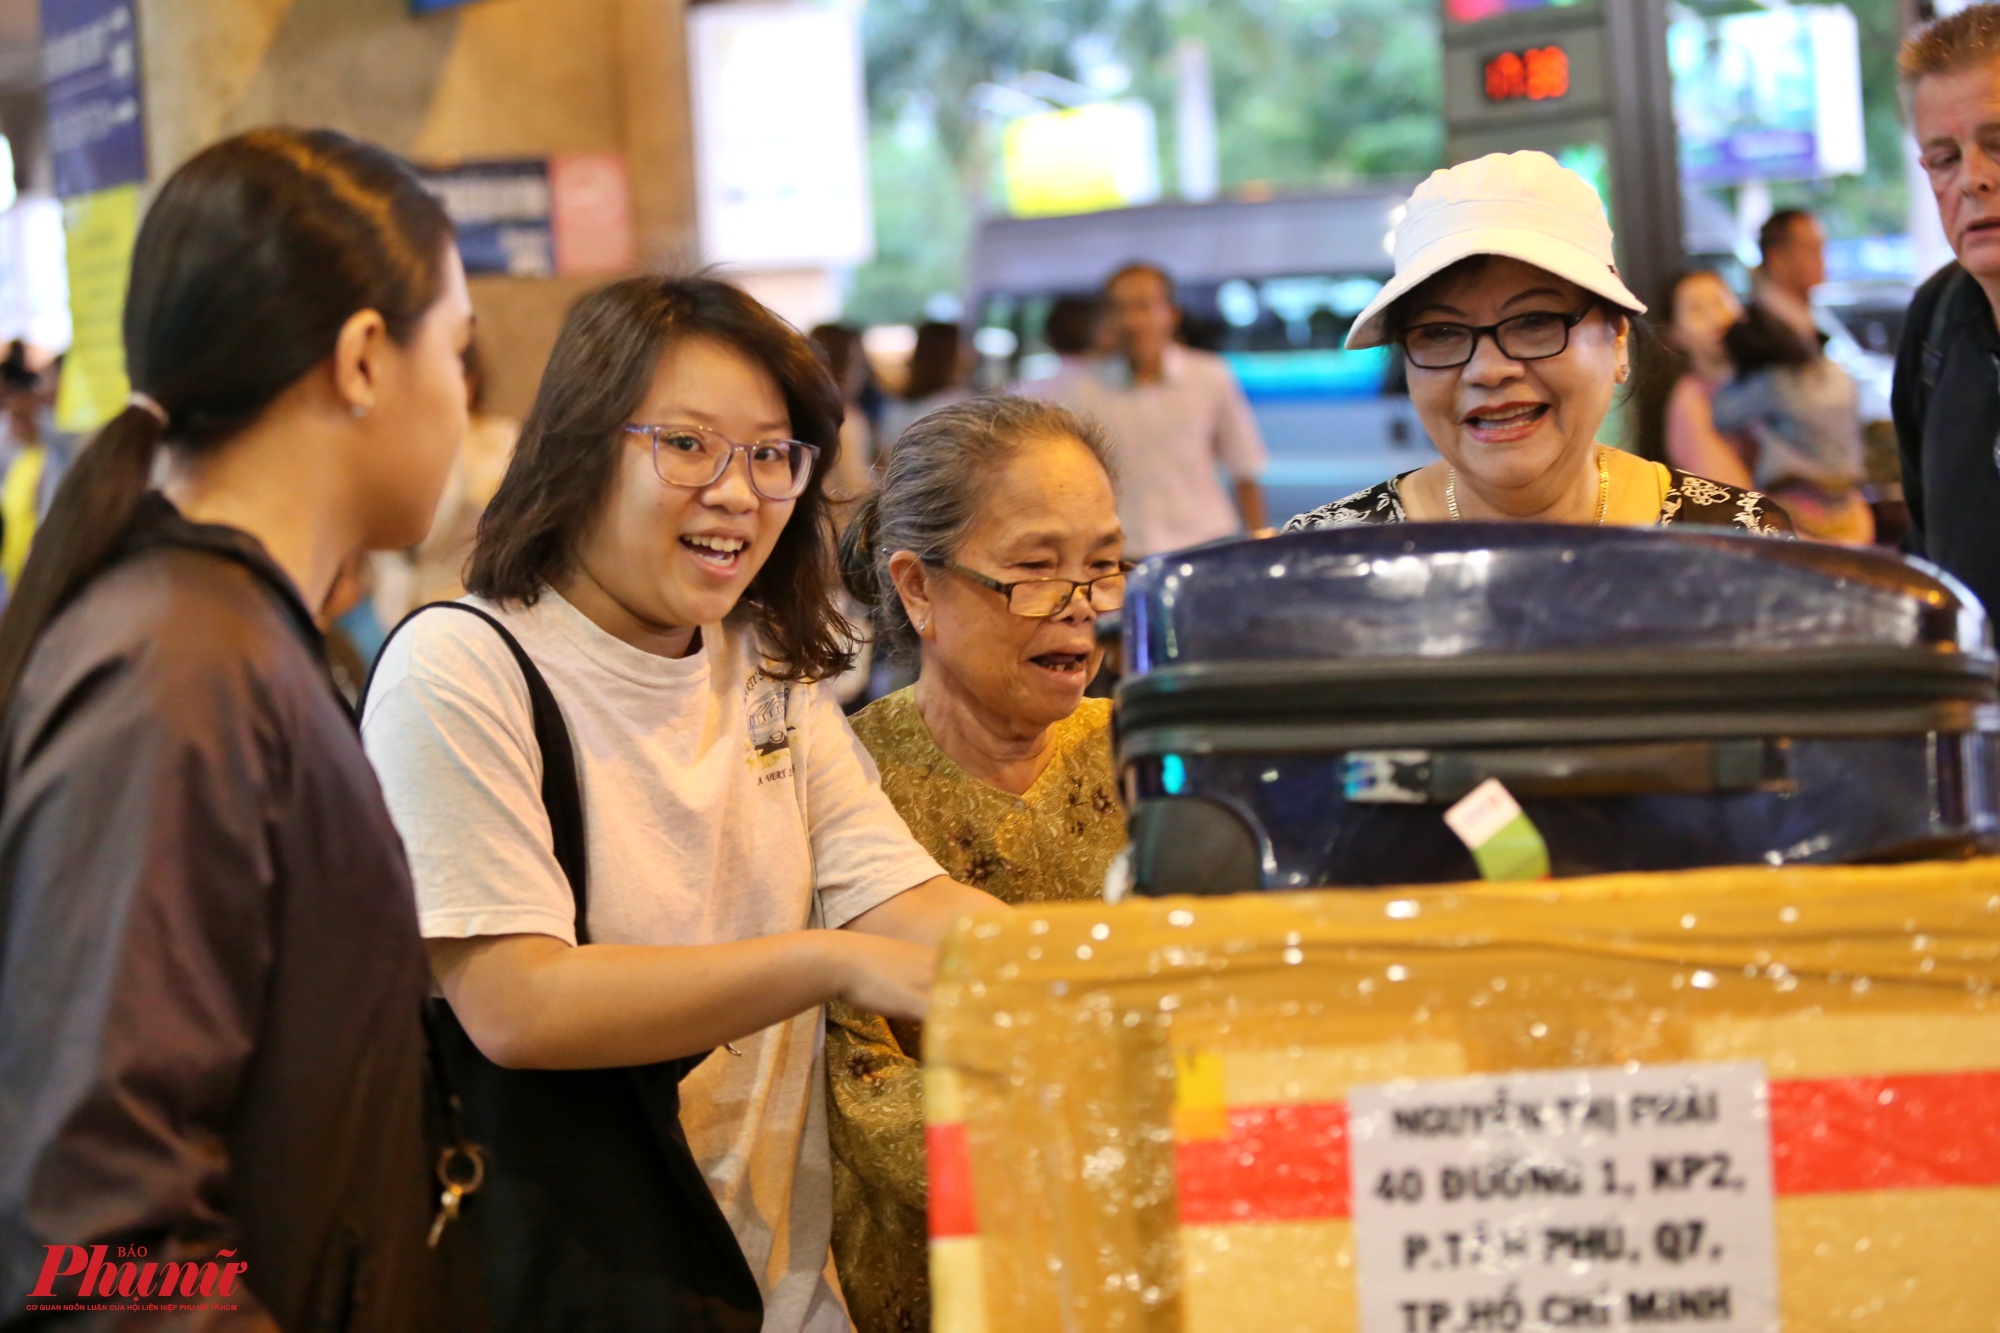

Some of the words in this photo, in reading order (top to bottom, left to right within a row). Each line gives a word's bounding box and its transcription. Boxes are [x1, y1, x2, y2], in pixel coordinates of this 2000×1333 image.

[766, 768, 786, 782] VERY
[1376, 1167, 1424, 1201] 40
[1602, 1159, 1636, 1198] 1,
[1650, 1153, 1746, 1192] KP2,
[1626, 1288, 1732, 1323] MINH
